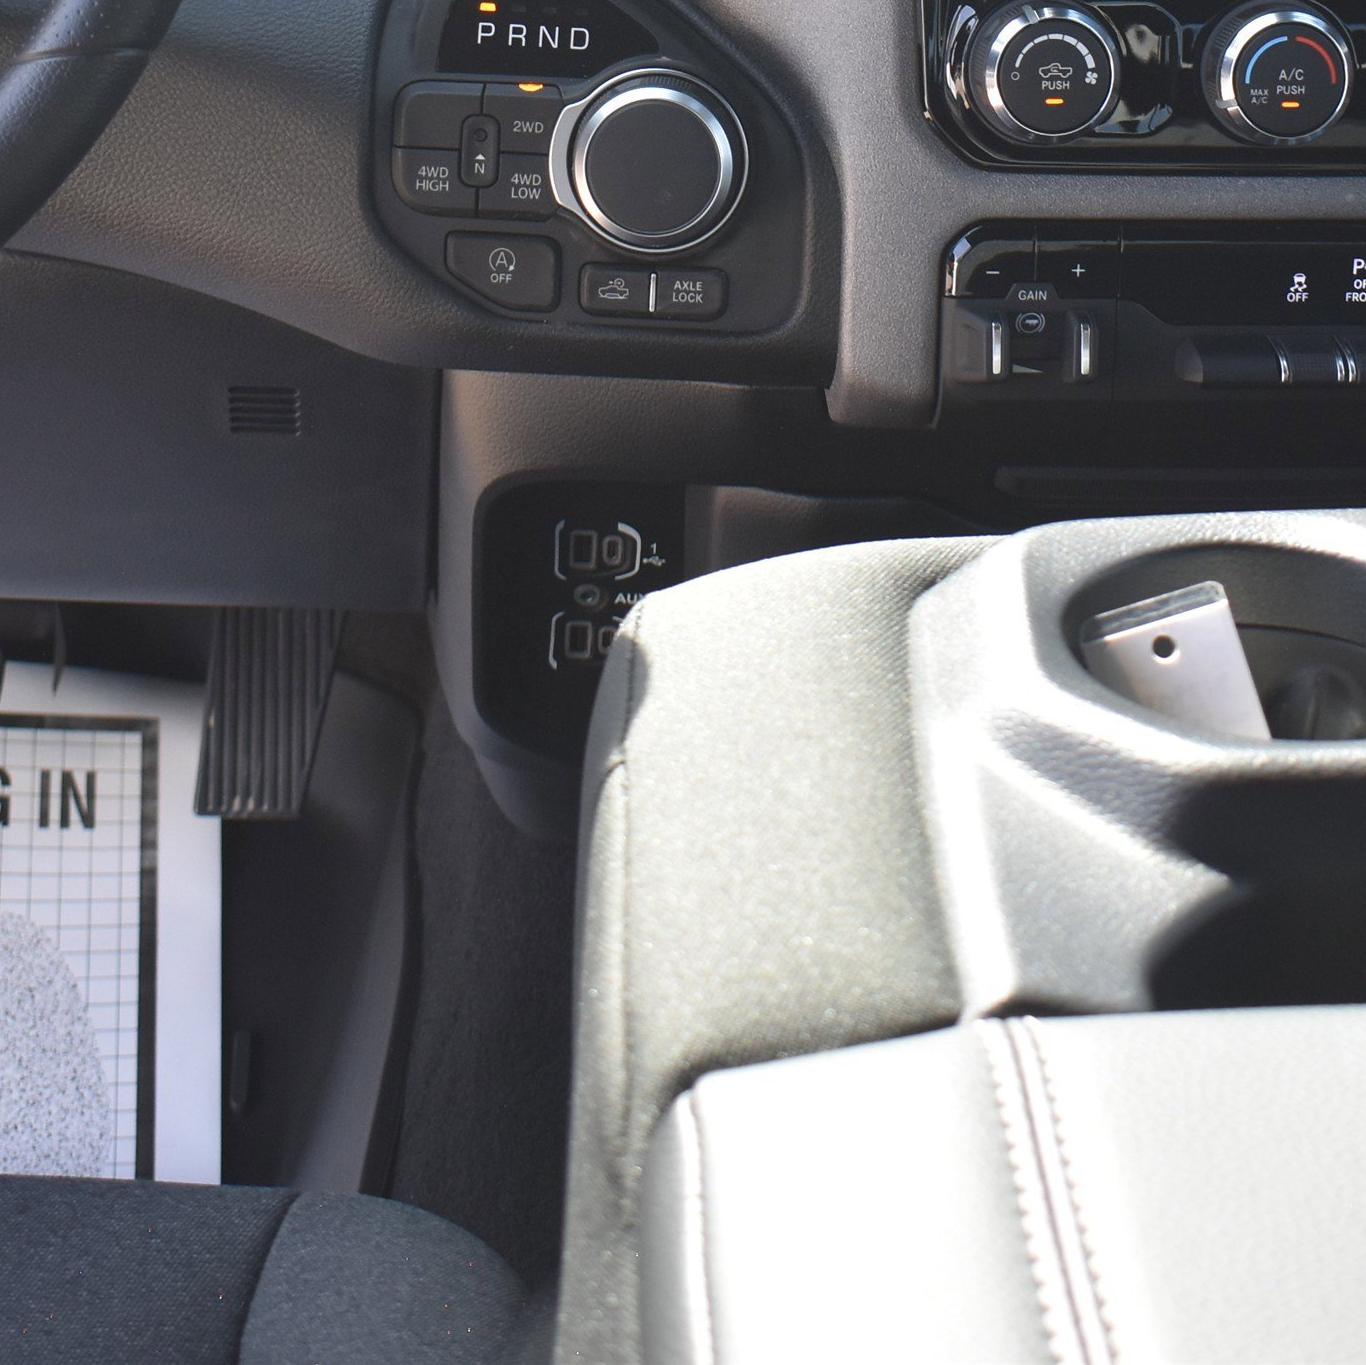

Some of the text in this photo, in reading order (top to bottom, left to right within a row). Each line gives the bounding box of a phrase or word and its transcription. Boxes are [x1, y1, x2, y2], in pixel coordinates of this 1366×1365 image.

[1278, 68, 1305, 81] A/C
[1041, 80, 1070, 91] PUSH
[1276, 85, 1306, 95] PUSH
[1250, 88, 1269, 97] MAX
[1251, 96, 1268, 105] A/C
[512, 120, 544, 134] 2WD
[417, 165, 449, 179] 4WD
[474, 163, 485, 175] N
[415, 178, 450, 192] HIGH
[510, 173, 542, 187] 4WD
[511, 186, 541, 200] LOW
[490, 272, 512, 284] OFF
[673, 280, 703, 292] AXLE
[671, 291, 703, 304] LOCK
[1018, 290, 1047, 302] GAIN
[1286, 292, 1309, 302] OFF
[651, 543, 657, 554] 1
[38, 768, 97, 829] IN
